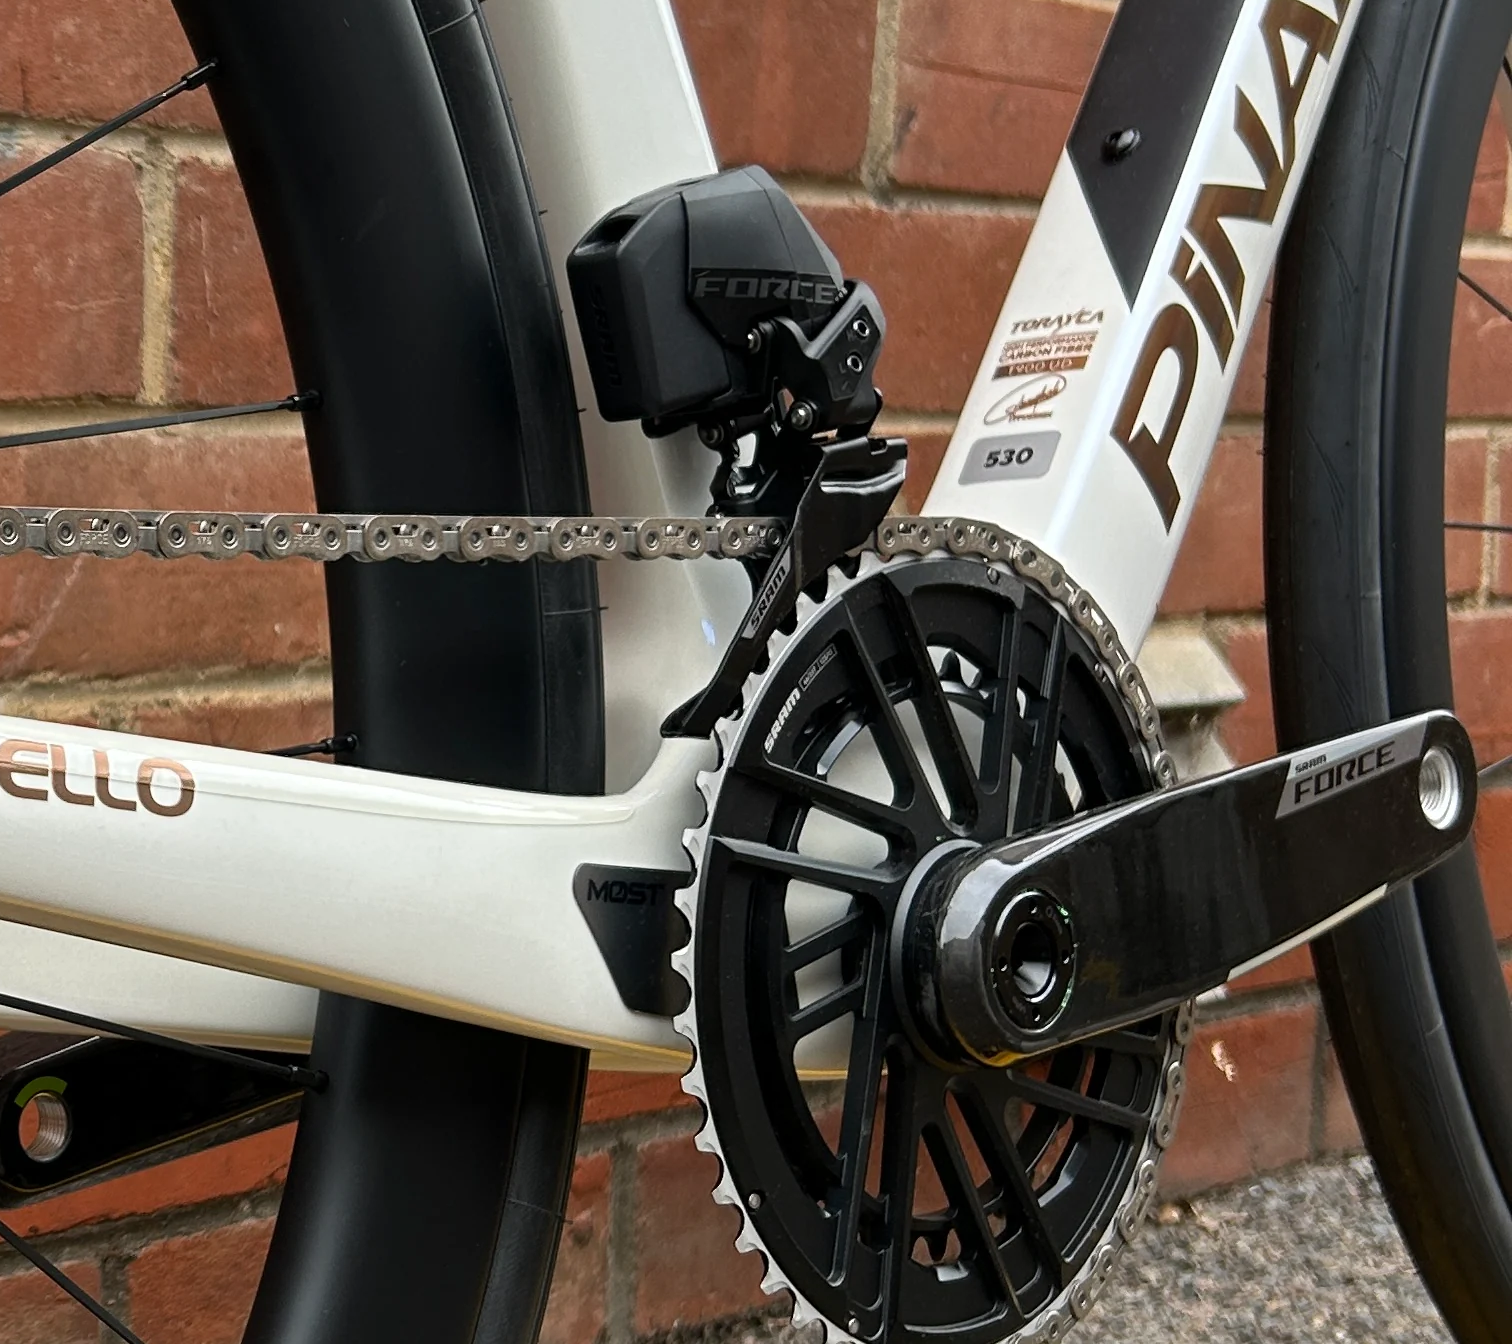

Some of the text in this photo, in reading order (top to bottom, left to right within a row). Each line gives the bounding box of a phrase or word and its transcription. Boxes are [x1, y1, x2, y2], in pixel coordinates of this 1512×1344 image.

[694, 276, 837, 304] FORCE
[983, 446, 1034, 468] 530
[750, 564, 786, 632] SRAM
[763, 687, 801, 754] SRAM
[1294, 753, 1327, 774] SRAM
[1294, 740, 1395, 805] FORCE
